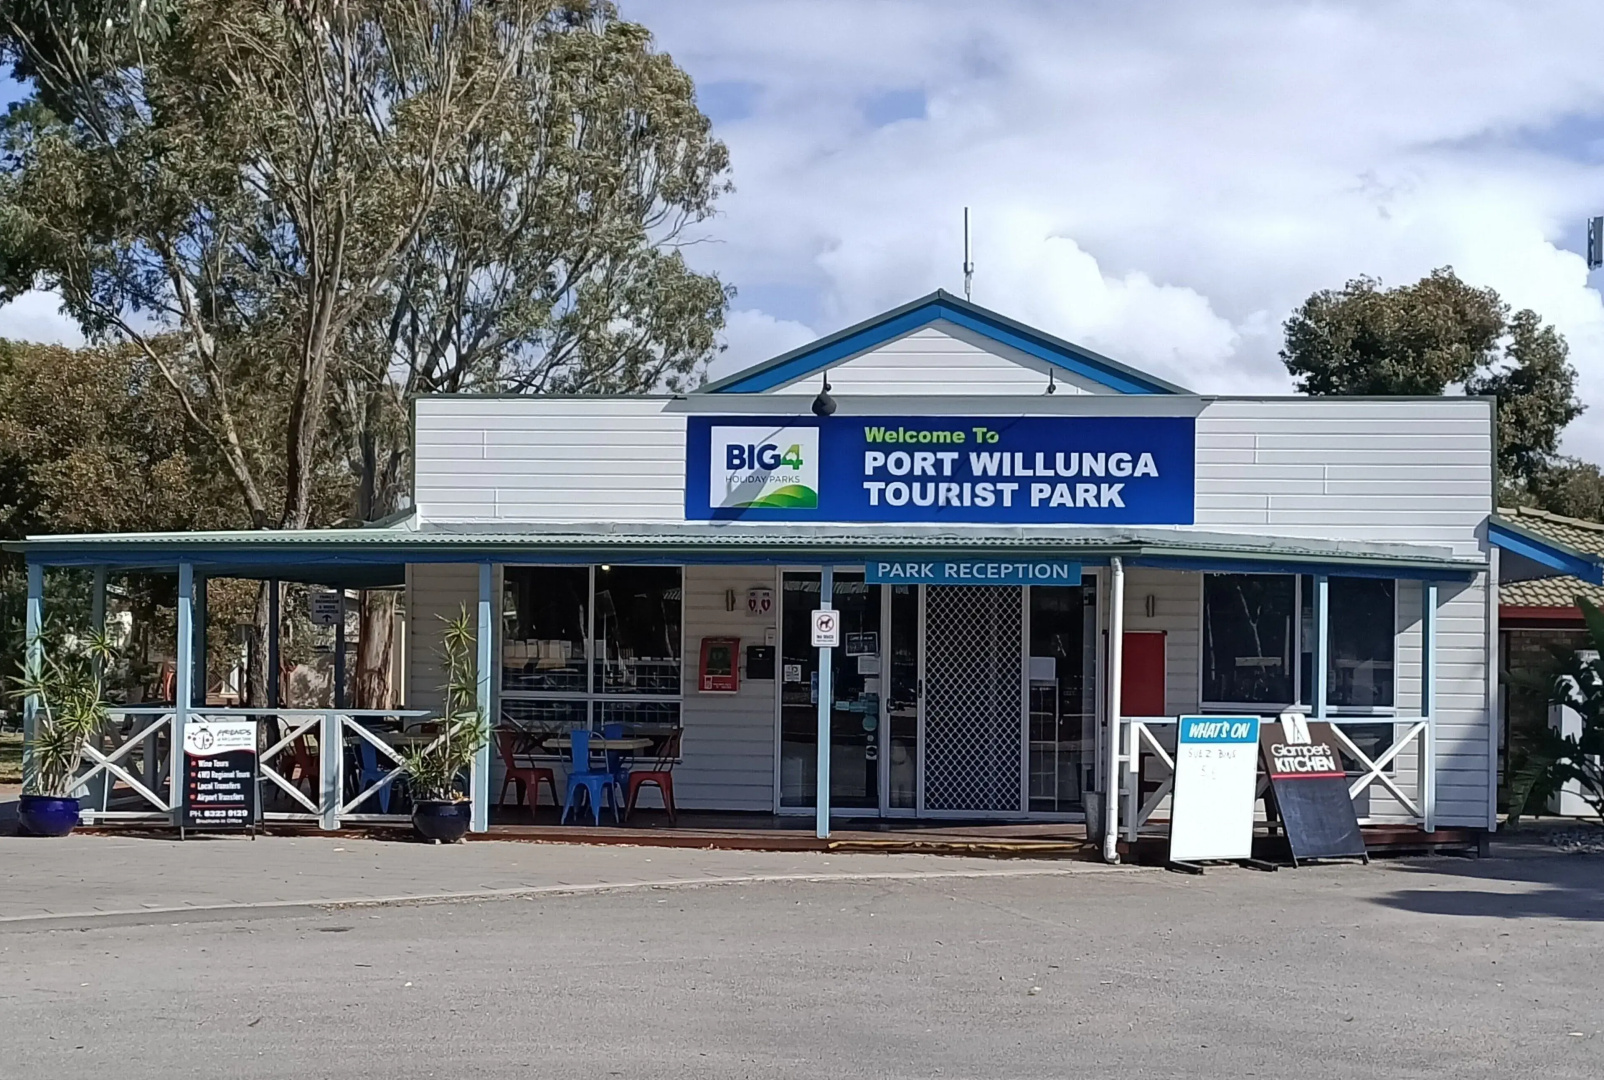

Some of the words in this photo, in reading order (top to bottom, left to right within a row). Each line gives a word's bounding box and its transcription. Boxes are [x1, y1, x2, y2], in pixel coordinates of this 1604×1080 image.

[864, 427, 966, 443] Welcome
[972, 427, 1000, 443] To
[726, 444, 803, 470] BIG4
[864, 451, 959, 476] PORT
[969, 452, 1159, 477] WILLUNGA
[725, 475, 767, 483] HOLIDAY
[769, 475, 800, 483] PARKS
[863, 482, 1018, 507] TOURIST
[1030, 483, 1126, 508] PARK
[878, 562, 934, 578] PARK
[944, 563, 1069, 580] RECEPTION
[1189, 721, 1230, 739] WHAT'S
[1231, 722, 1251, 739] ON
[1274, 756, 1336, 772] KITCHEN
